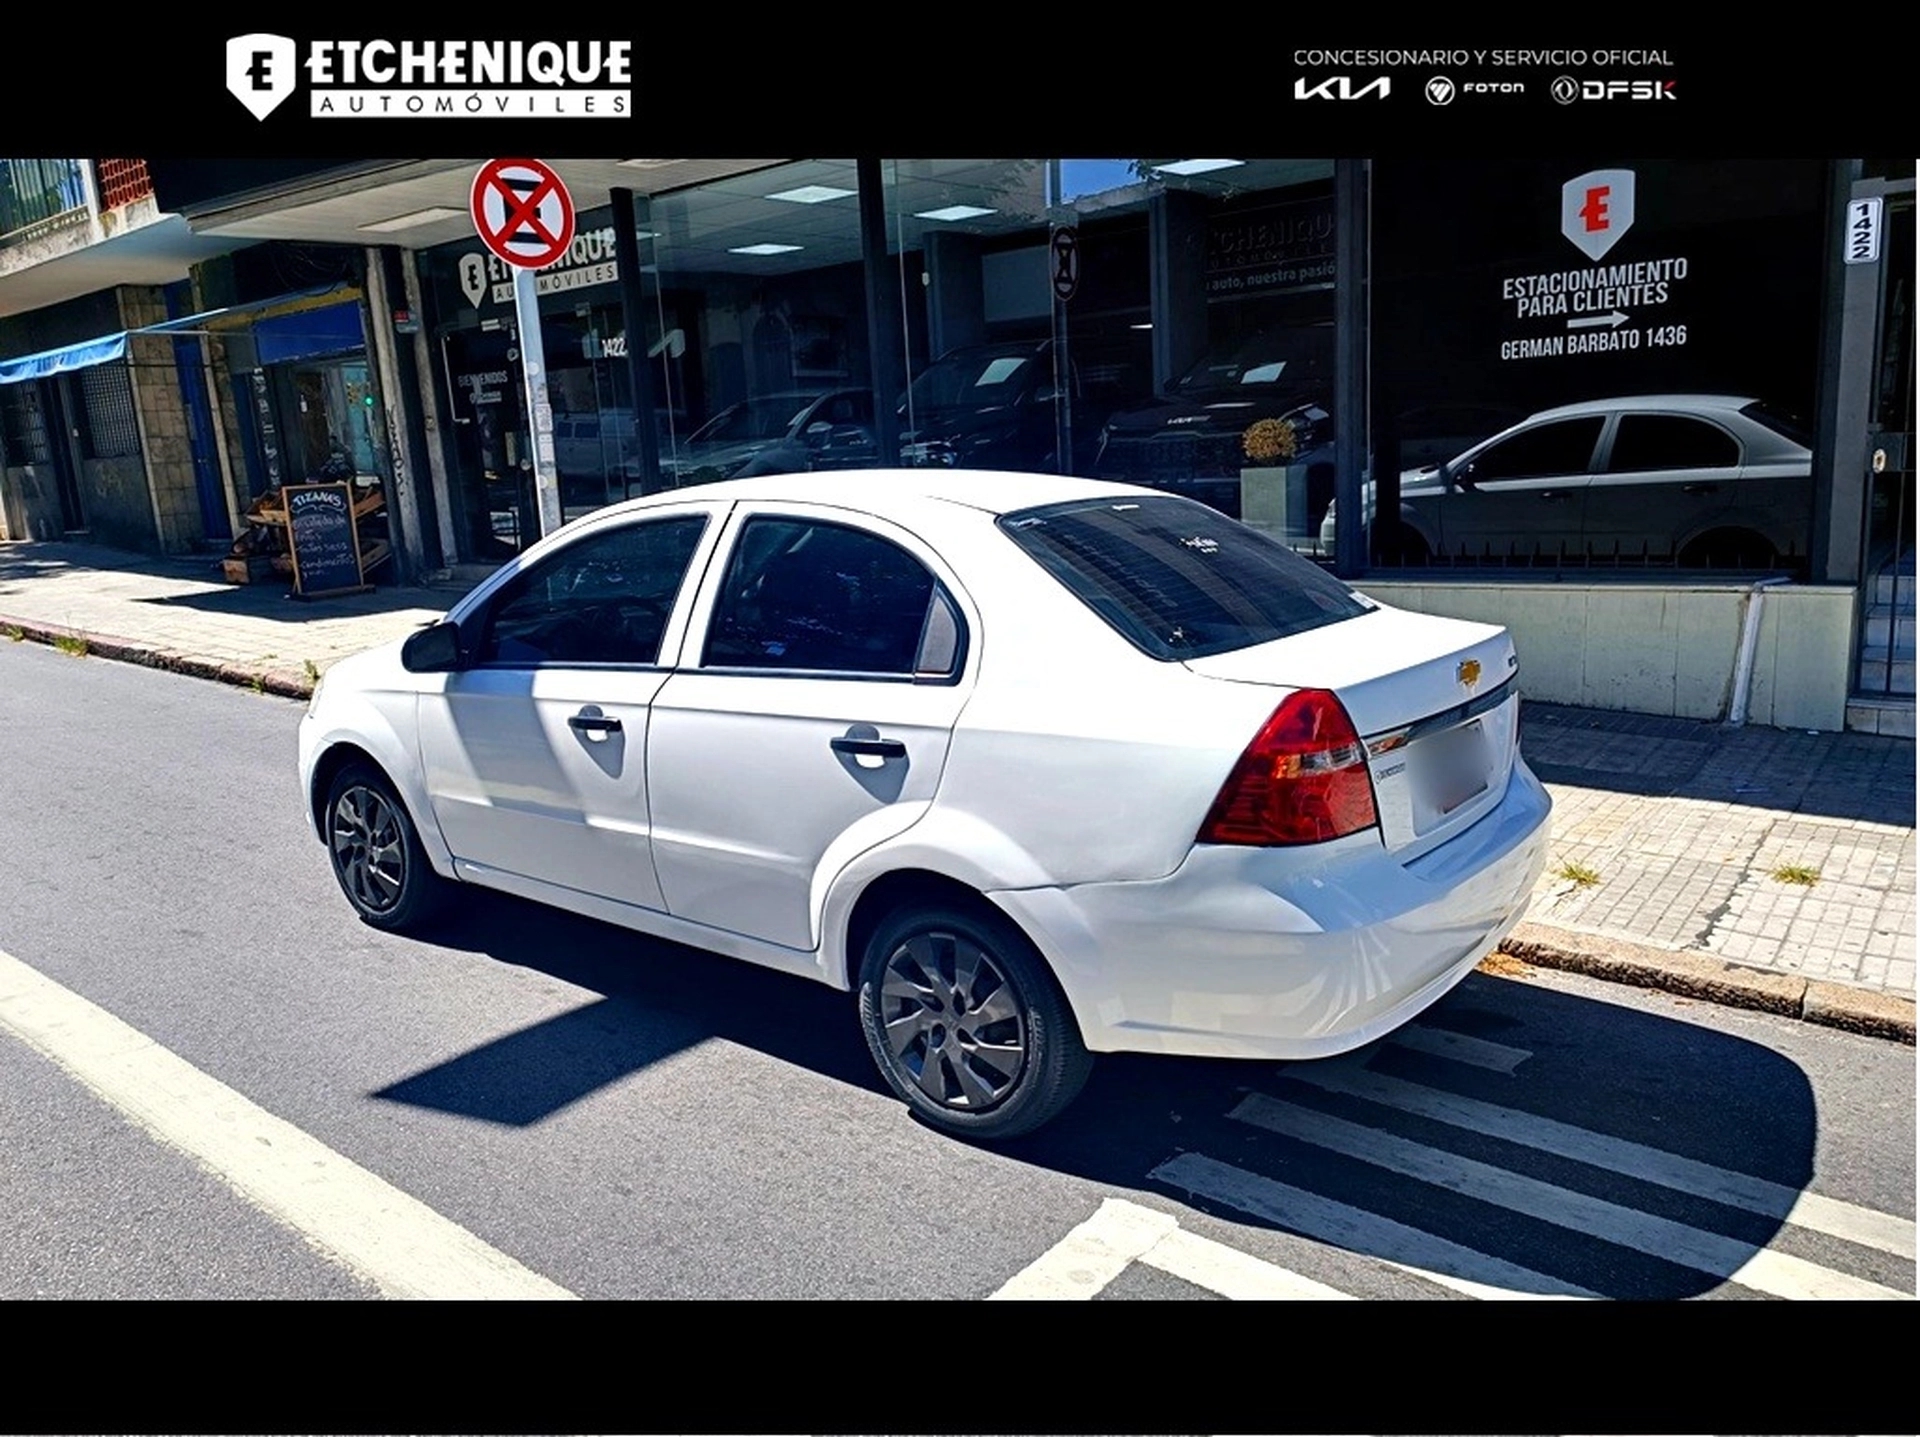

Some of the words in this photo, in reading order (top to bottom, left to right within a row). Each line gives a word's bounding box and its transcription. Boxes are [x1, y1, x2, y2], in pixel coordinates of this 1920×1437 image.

[1852, 203, 1872, 259] 1422
[496, 264, 615, 300] AUMÓVILES
[1247, 268, 1296, 286] nuestra
[1299, 260, 1336, 283] pasió
[1503, 257, 1688, 300] ESTACIONAMIENTO
[1517, 293, 1568, 319] PARA
[1573, 281, 1669, 313] CLIENTES
[1501, 336, 1564, 360] GERMAN
[1567, 328, 1640, 355] BARBATO
[1646, 325, 1688, 347] 1436
